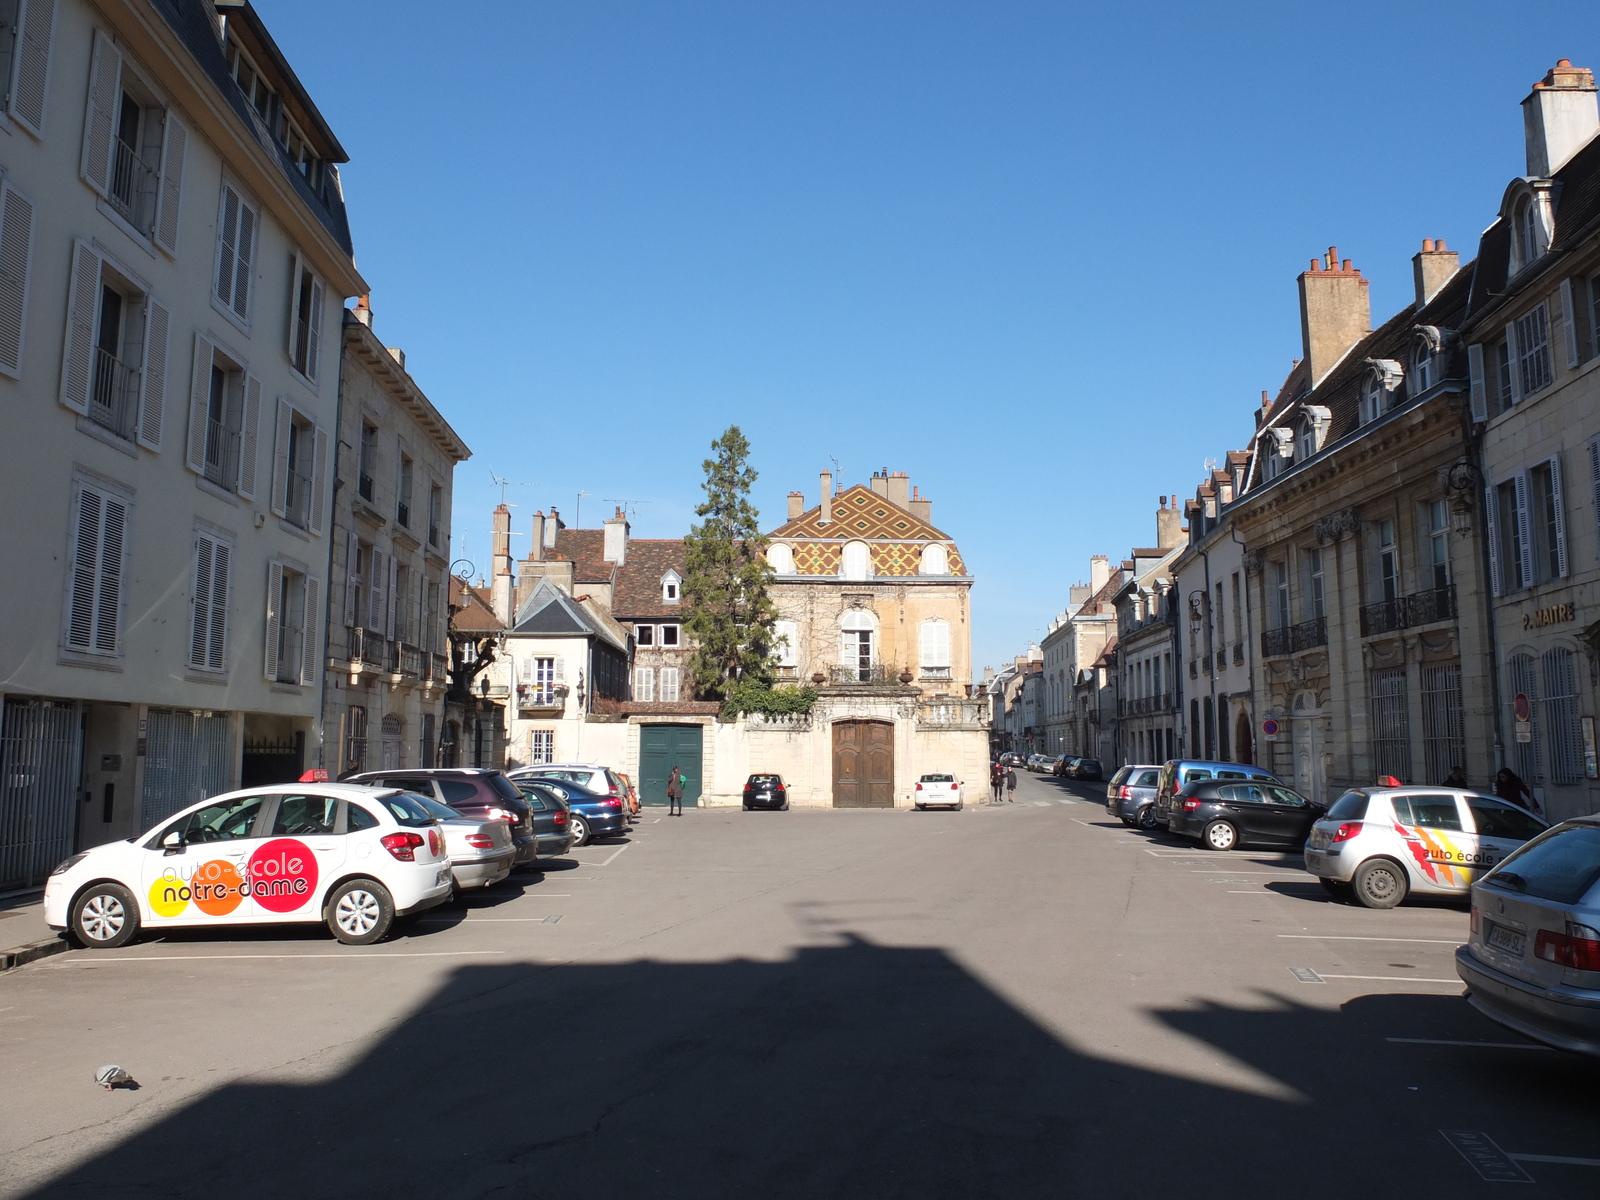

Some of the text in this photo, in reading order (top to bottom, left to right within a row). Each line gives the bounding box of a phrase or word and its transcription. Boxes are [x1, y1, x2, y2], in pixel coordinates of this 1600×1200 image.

[1535, 602, 1575, 628] MAITRE
[163, 852, 304, 882] auto-école
[1423, 849, 1452, 860] auto
[1457, 850, 1493, 864] école
[163, 875, 308, 902] notre-dame
